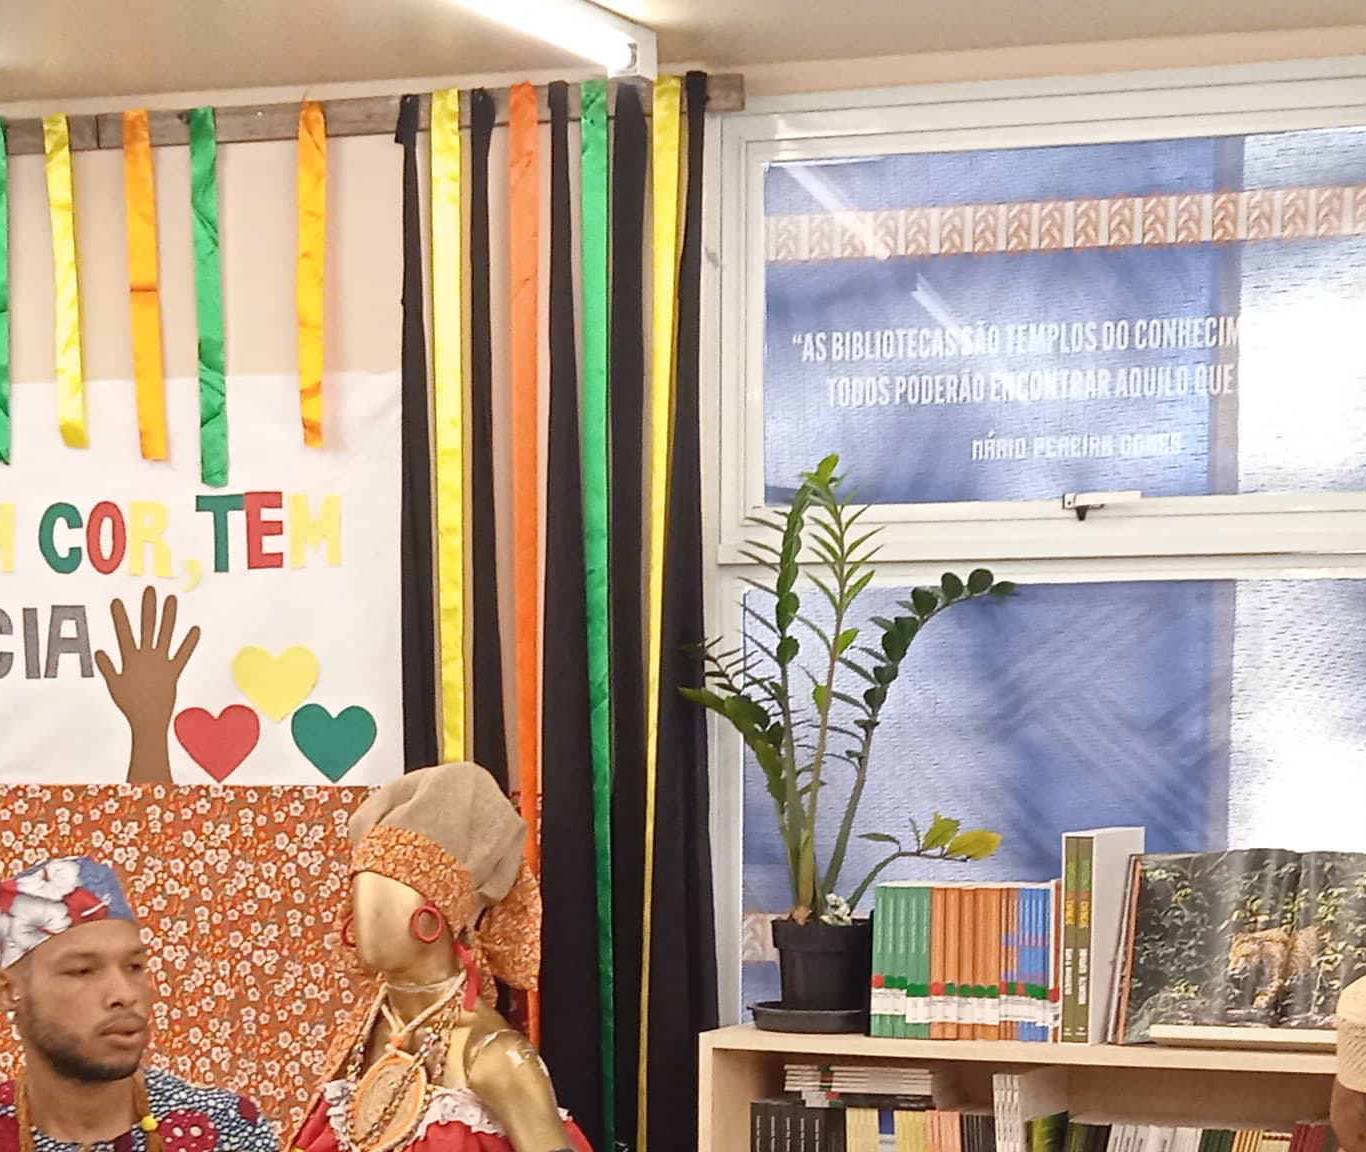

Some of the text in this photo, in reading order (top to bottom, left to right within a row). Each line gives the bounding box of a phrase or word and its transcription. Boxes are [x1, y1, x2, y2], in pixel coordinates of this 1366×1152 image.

[832, 327, 960, 361] BIBLIOTECAS
[1005, 322, 1096, 354] TEMPLOS
[1102, 320, 1131, 350] DO
[827, 362, 1234, 408] TODOS PODERÃO ENCONTRAR AQUILO QUE
[195, 489, 342, 574] TEM
